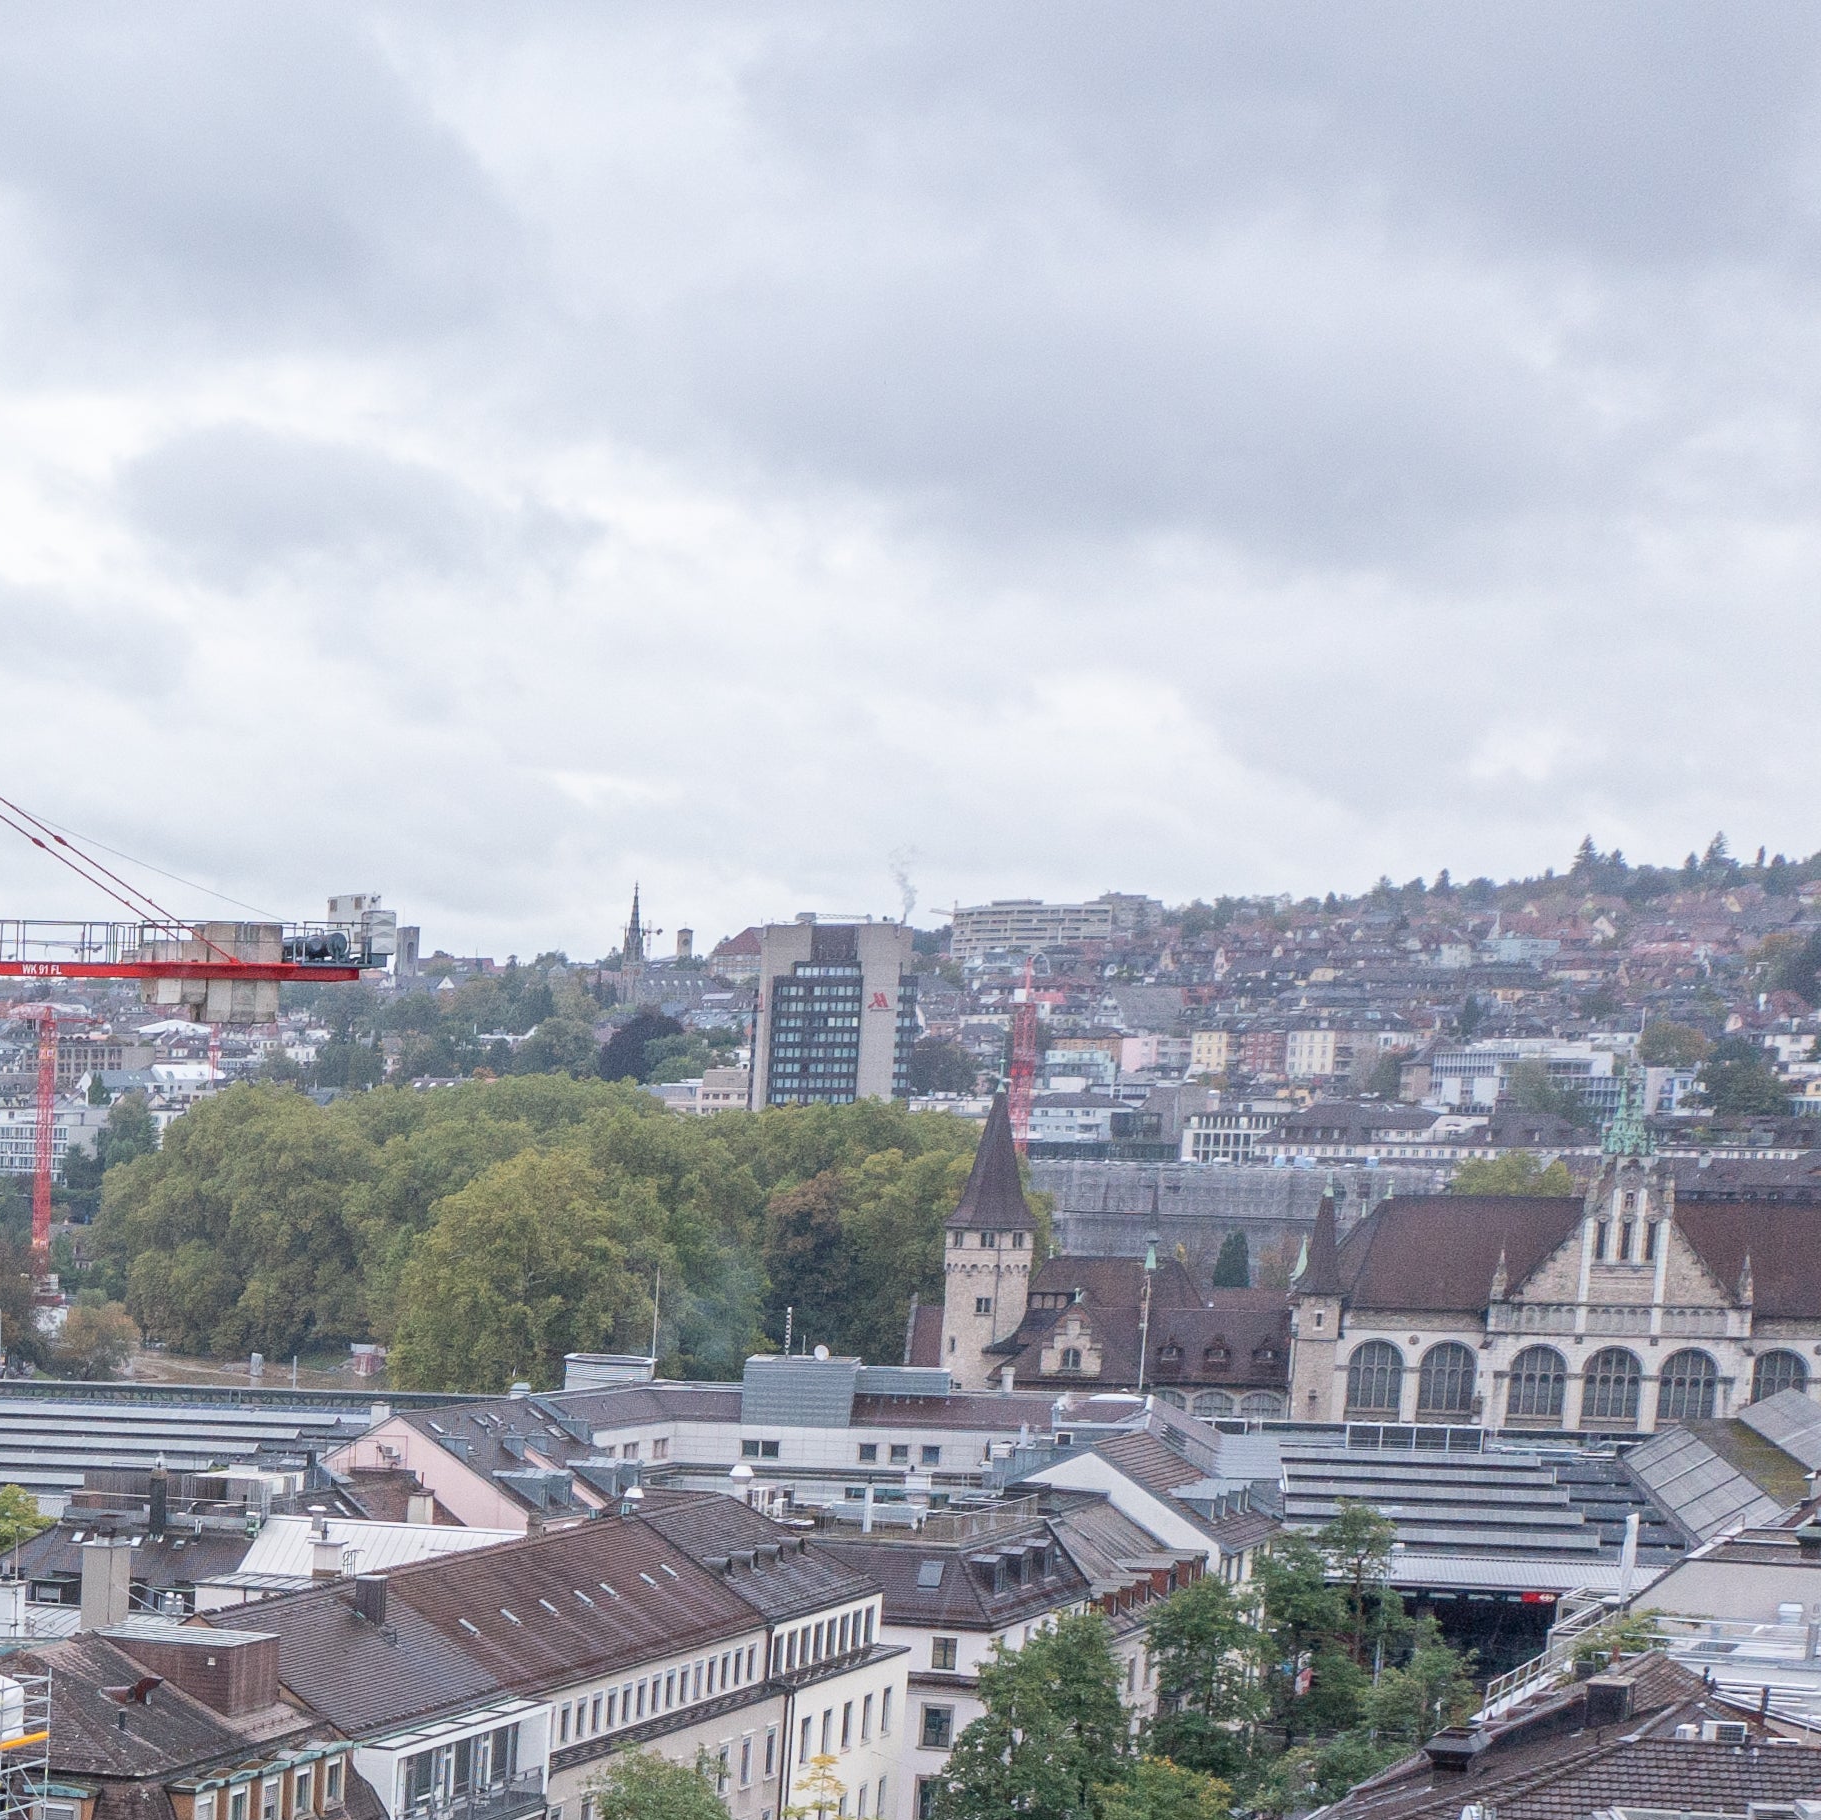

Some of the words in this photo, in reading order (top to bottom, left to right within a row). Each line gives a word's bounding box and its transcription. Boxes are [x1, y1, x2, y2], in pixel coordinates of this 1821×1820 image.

[22, 964, 37, 975] WK
[38, 964, 49, 975] 91
[51, 964, 63, 975] FL
